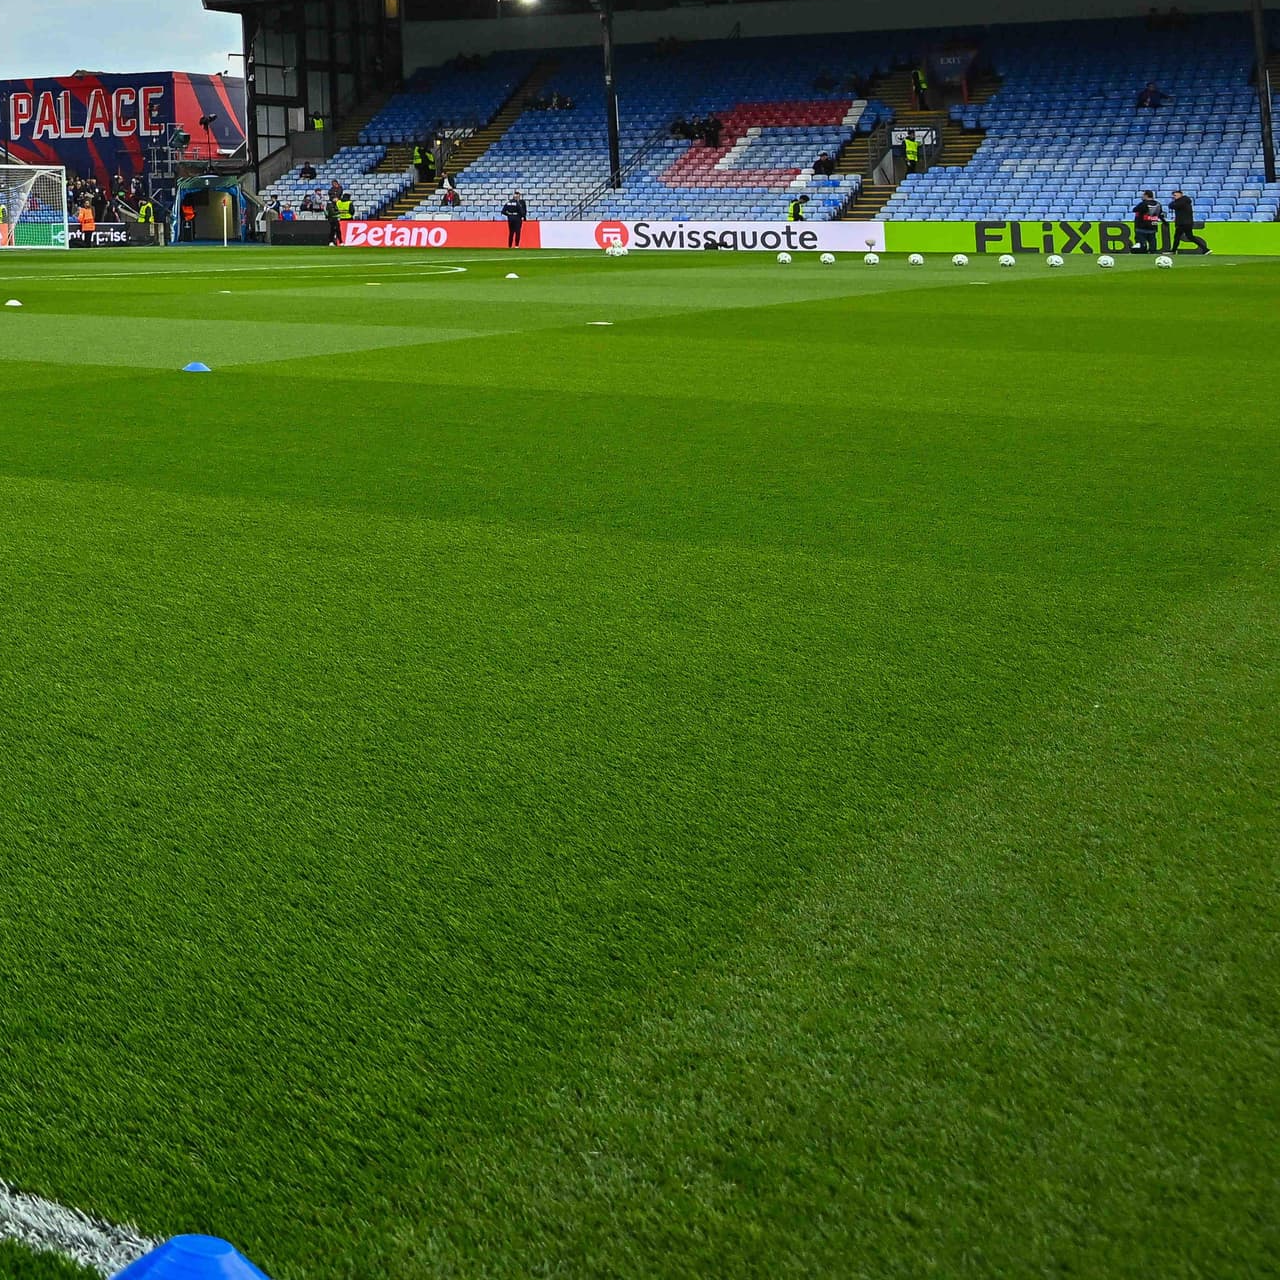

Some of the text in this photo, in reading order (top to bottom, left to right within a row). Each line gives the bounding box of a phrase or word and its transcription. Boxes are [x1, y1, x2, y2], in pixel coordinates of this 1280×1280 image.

[940, 56, 961, 65] EXIT
[10, 86, 165, 141] PALACE
[57, 228, 127, 245] entrprise
[343, 222, 448, 247] Betano
[633, 222, 818, 250] Swissquote
